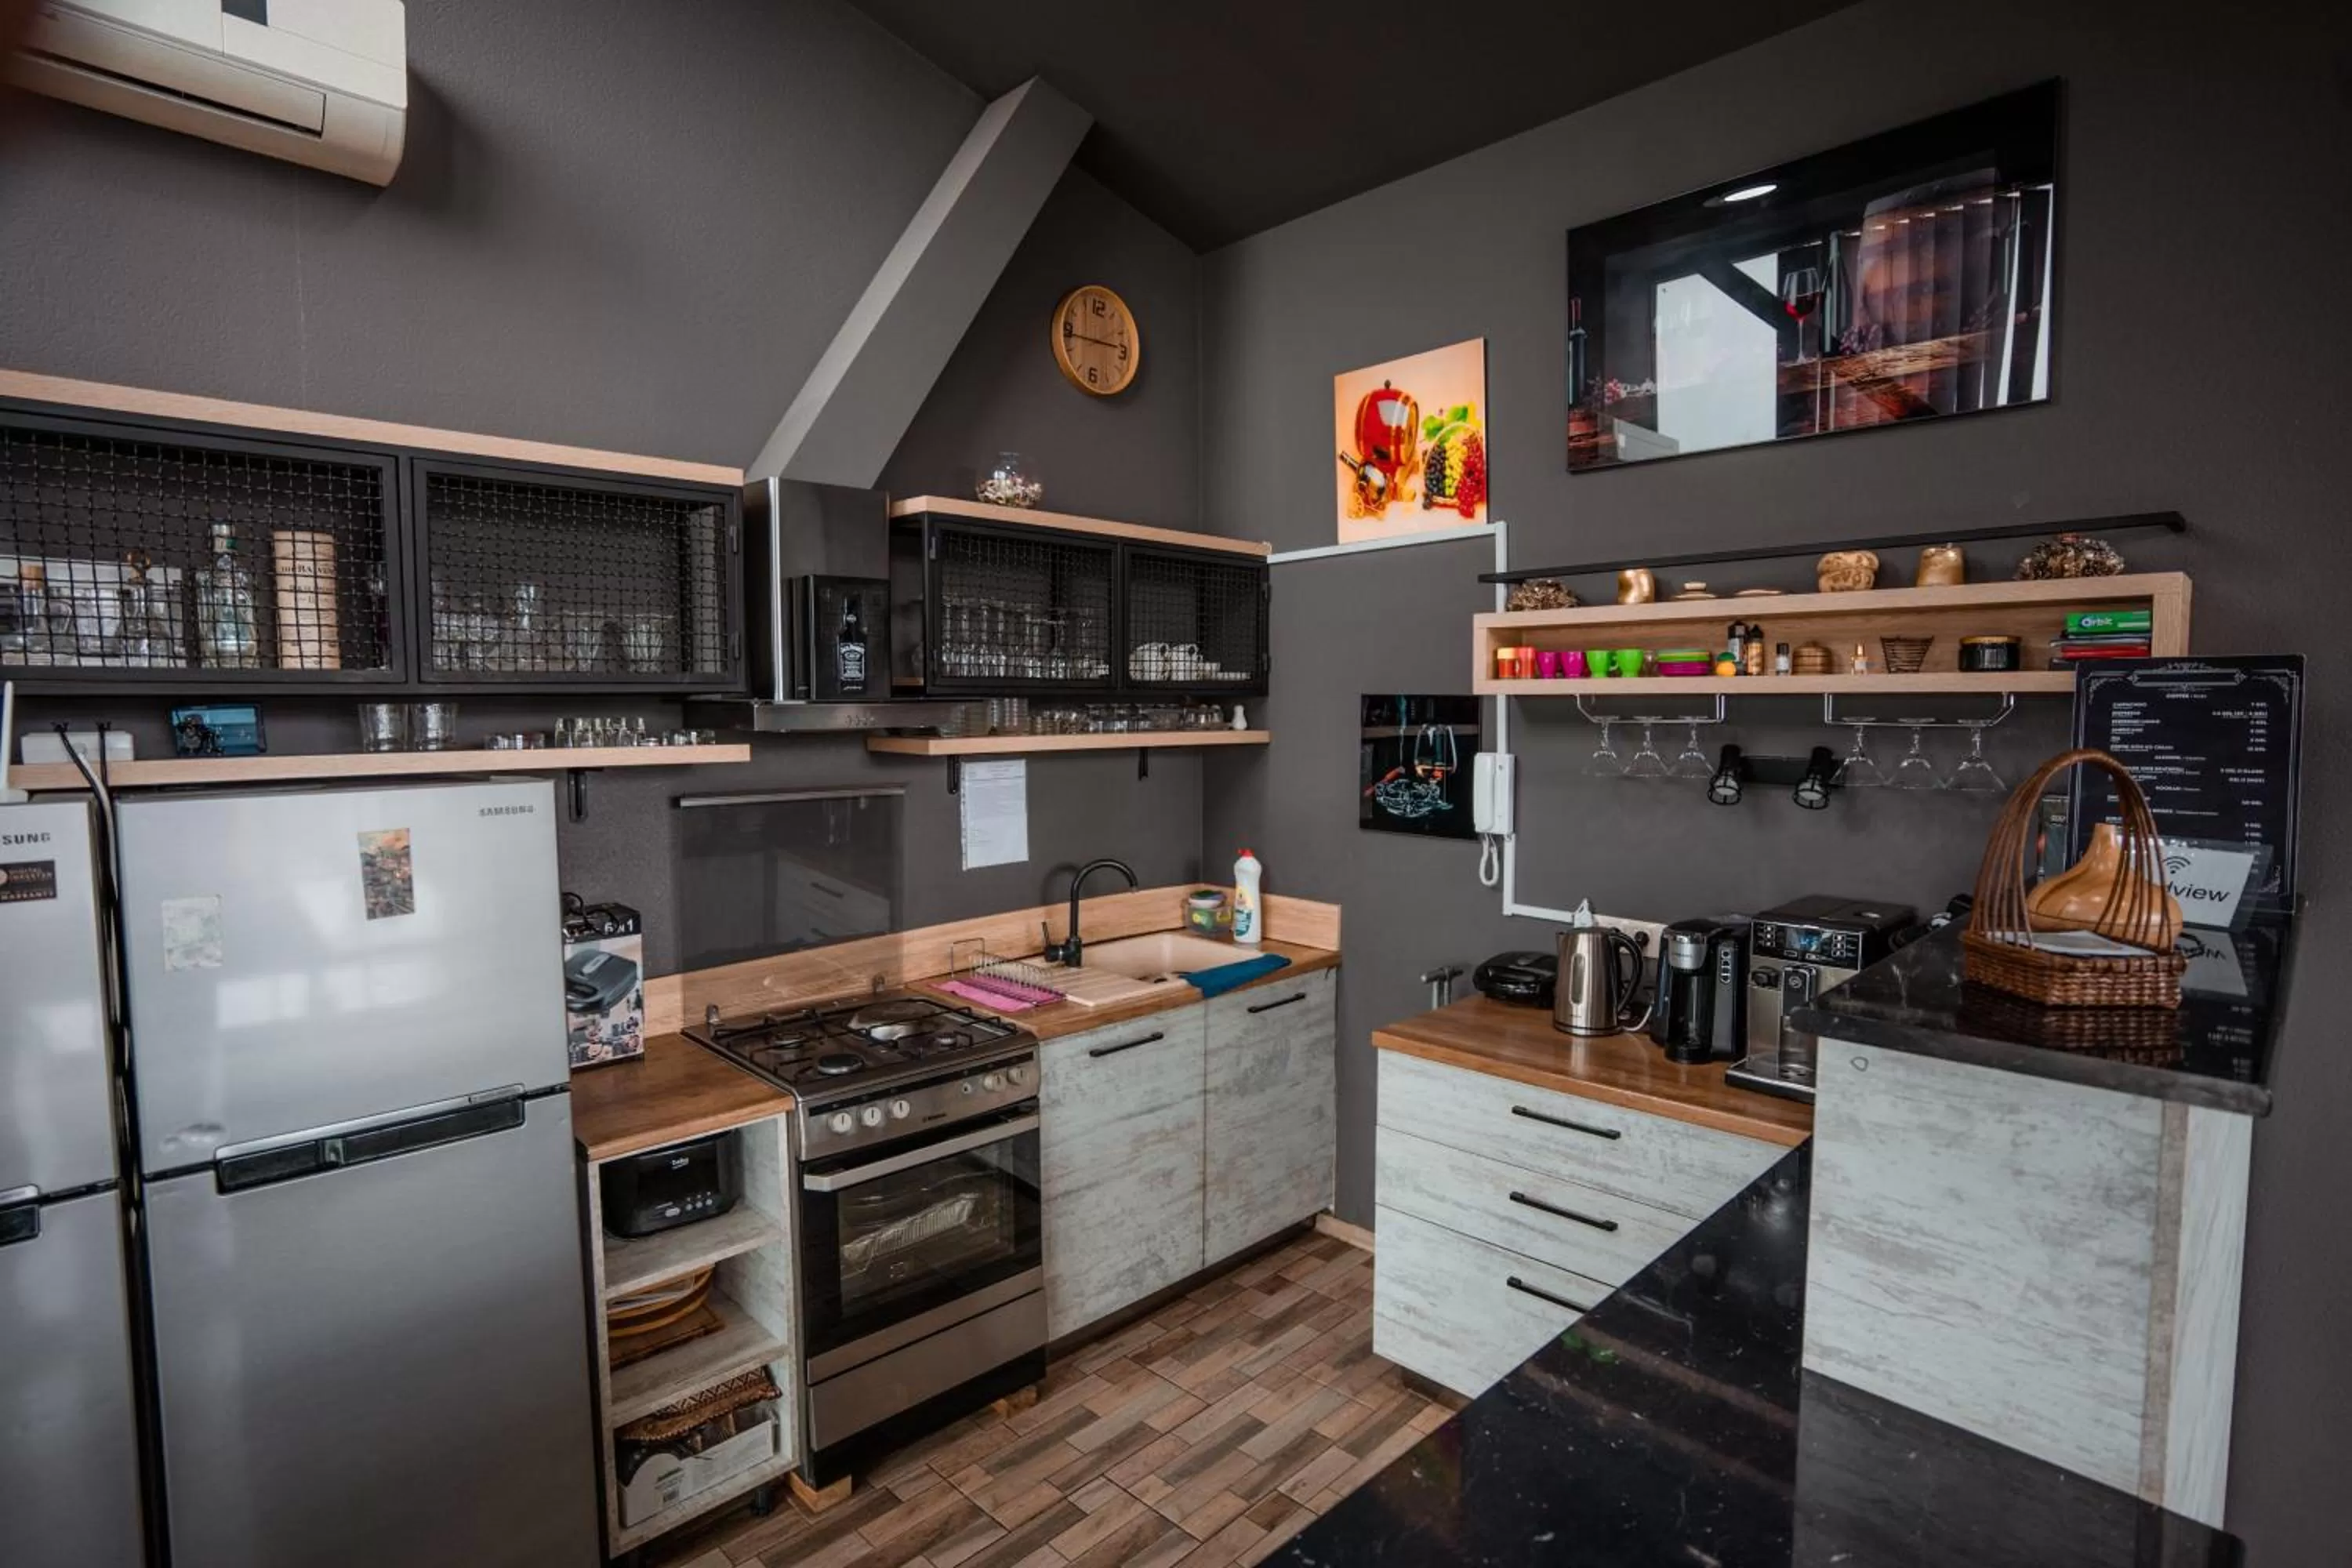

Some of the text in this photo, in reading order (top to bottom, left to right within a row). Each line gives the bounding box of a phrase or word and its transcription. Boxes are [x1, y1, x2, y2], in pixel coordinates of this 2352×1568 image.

[1092, 299, 1105, 318] 12
[1118, 344, 1127, 361] 3
[1088, 367, 1098, 383] 6
[479, 805, 534, 817] SAMSUNG
[626, 918, 633, 932] 1
